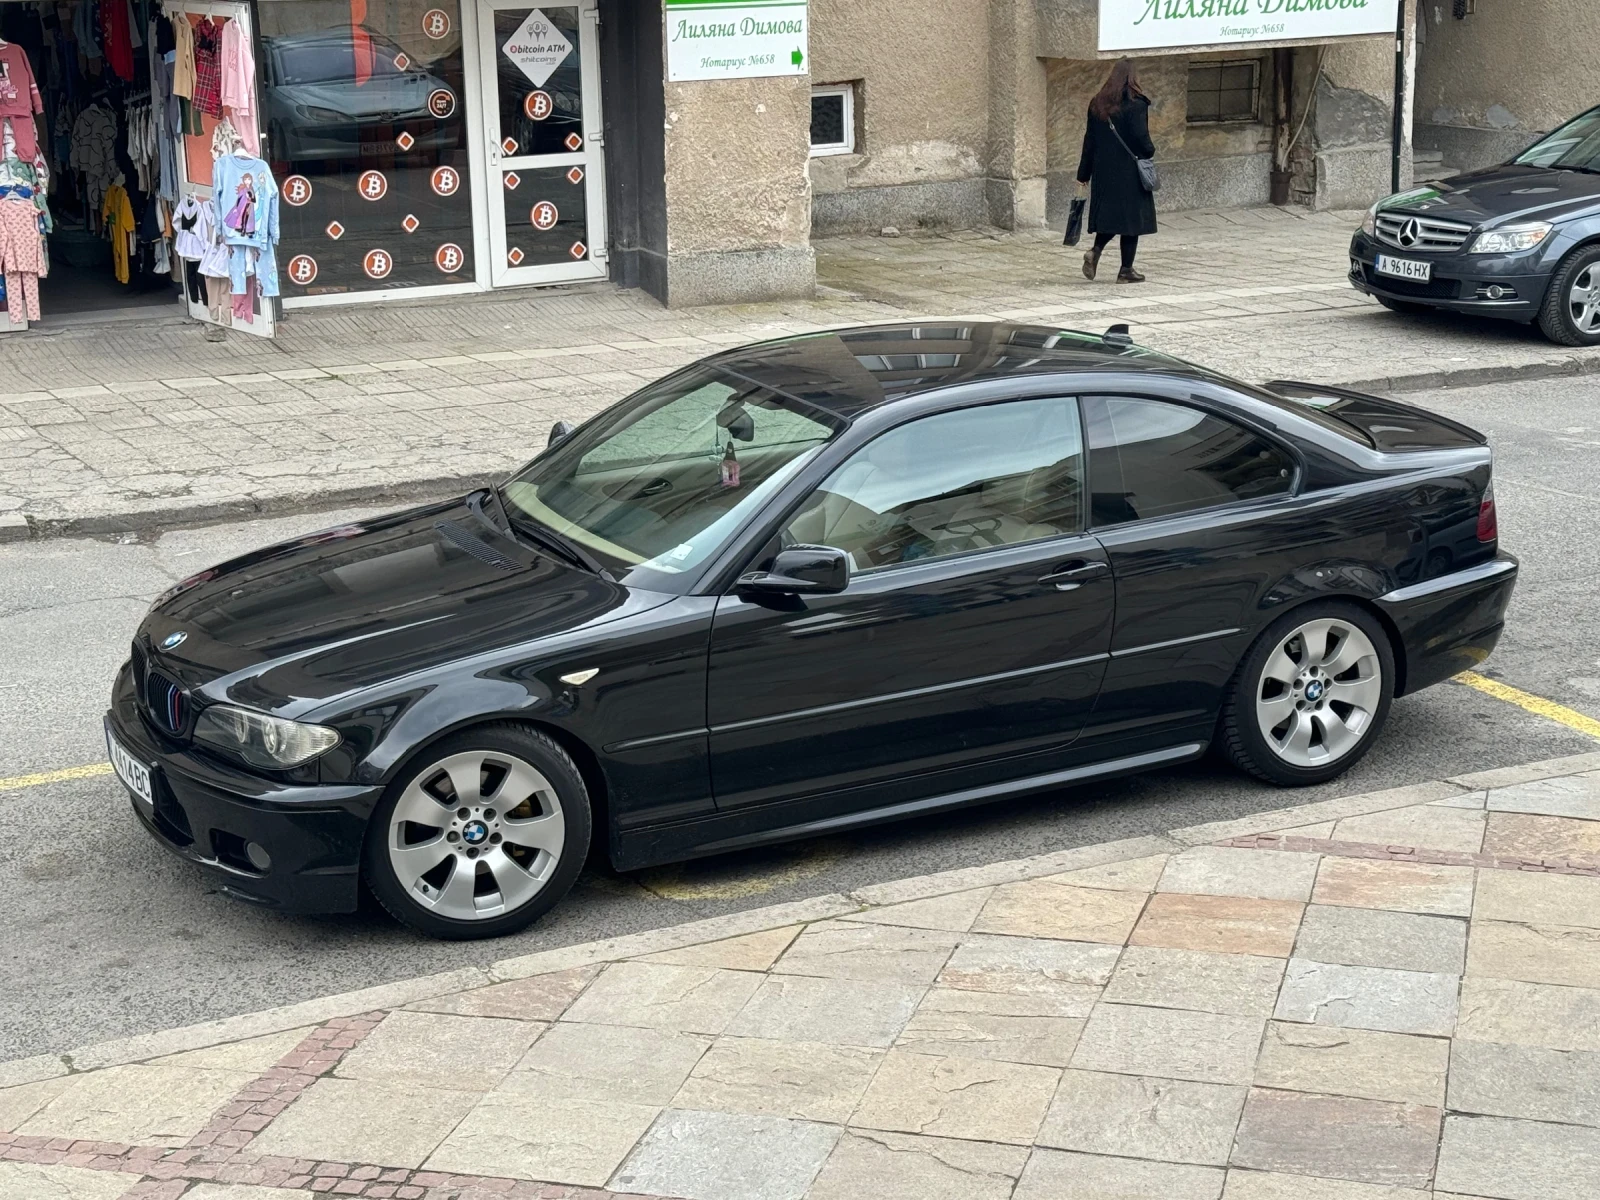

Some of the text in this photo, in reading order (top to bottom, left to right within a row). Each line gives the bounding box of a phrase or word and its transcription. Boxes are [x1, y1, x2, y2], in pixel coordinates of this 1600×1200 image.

[1133, 0, 1249, 25] Лиляна
[672, 17, 803, 42] Лиляна Димова
[1219, 25, 1260, 38] Нотариус
[517, 44, 565, 54] bitcoin ATM
[700, 53, 775, 70] Нотариус №658
[1382, 258, 1387, 271] A
